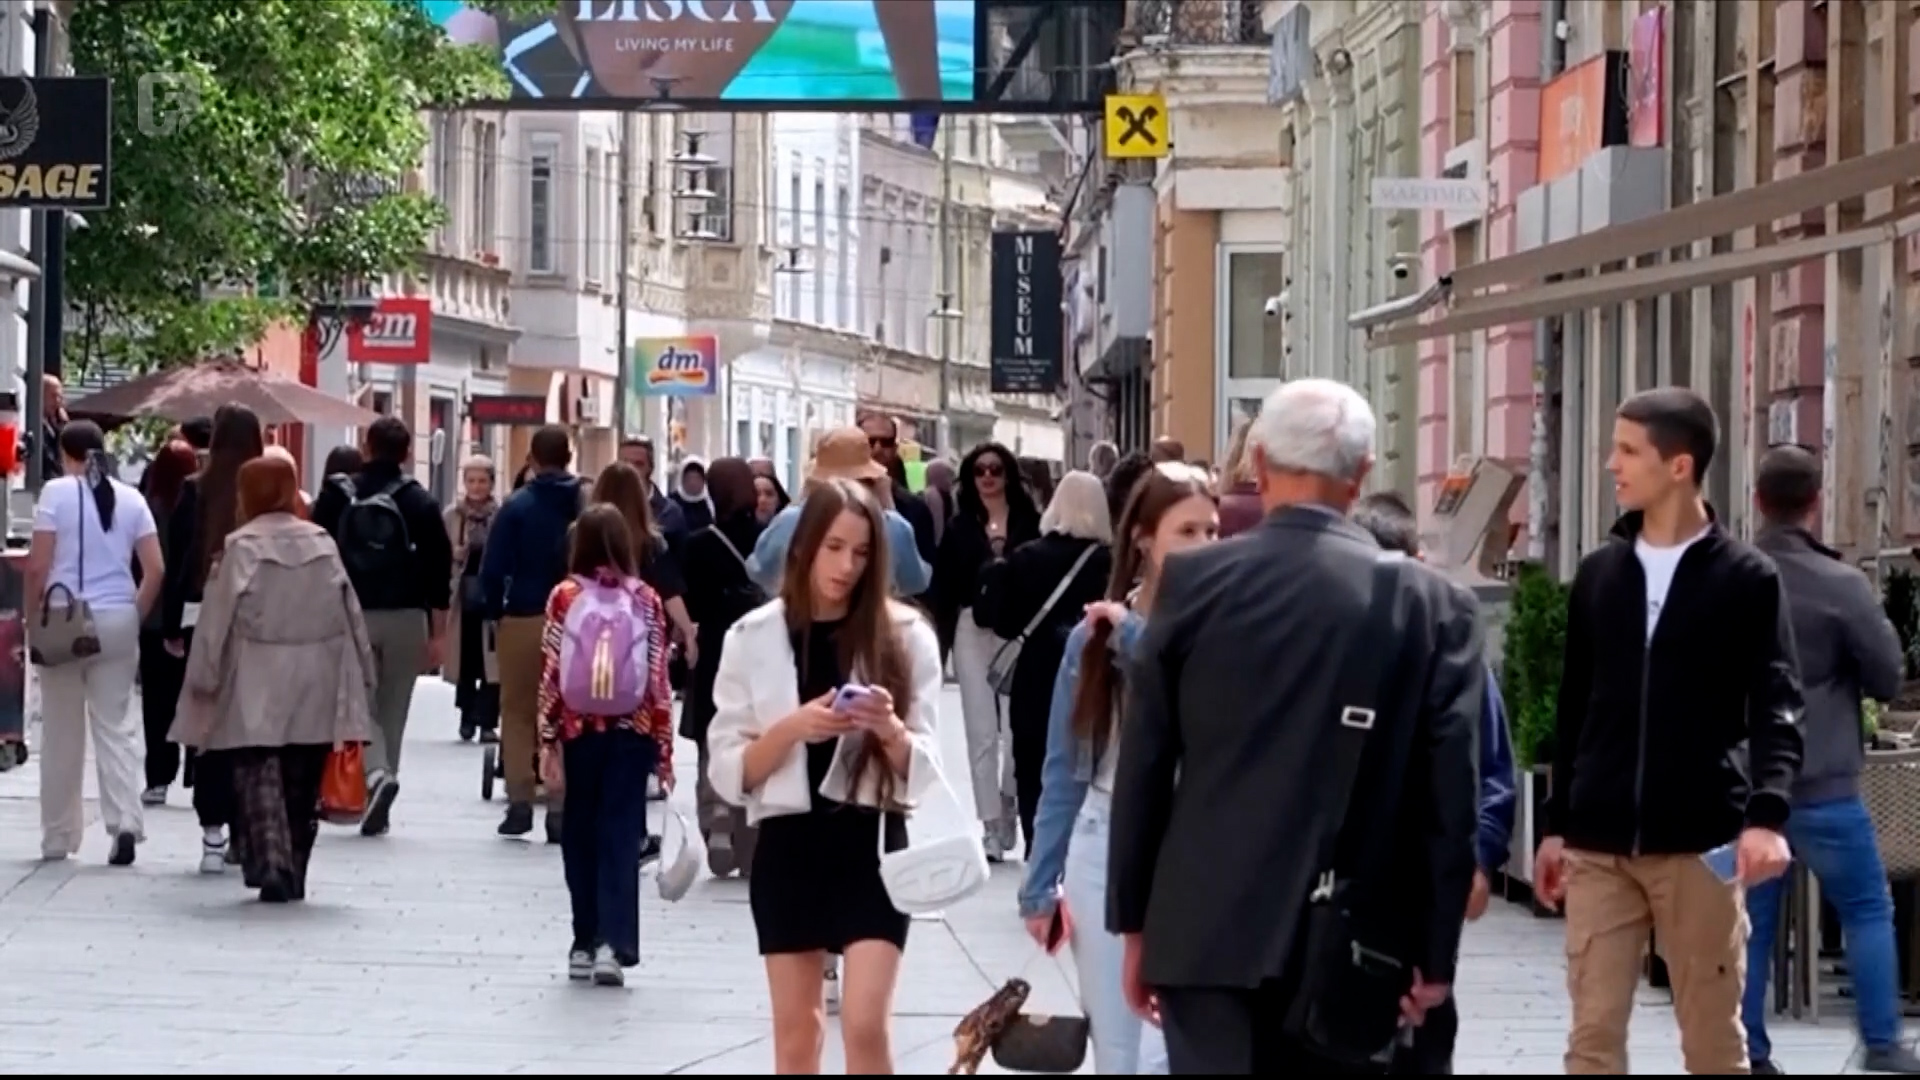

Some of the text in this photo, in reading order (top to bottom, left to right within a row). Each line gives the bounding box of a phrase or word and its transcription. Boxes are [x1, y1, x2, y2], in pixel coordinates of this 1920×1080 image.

[615, 38, 735, 51] LIVING MY LIFE
[0, 163, 103, 199] SAGE
[1014, 235, 1034, 356] MUSEUM
[657, 345, 700, 371] dm
